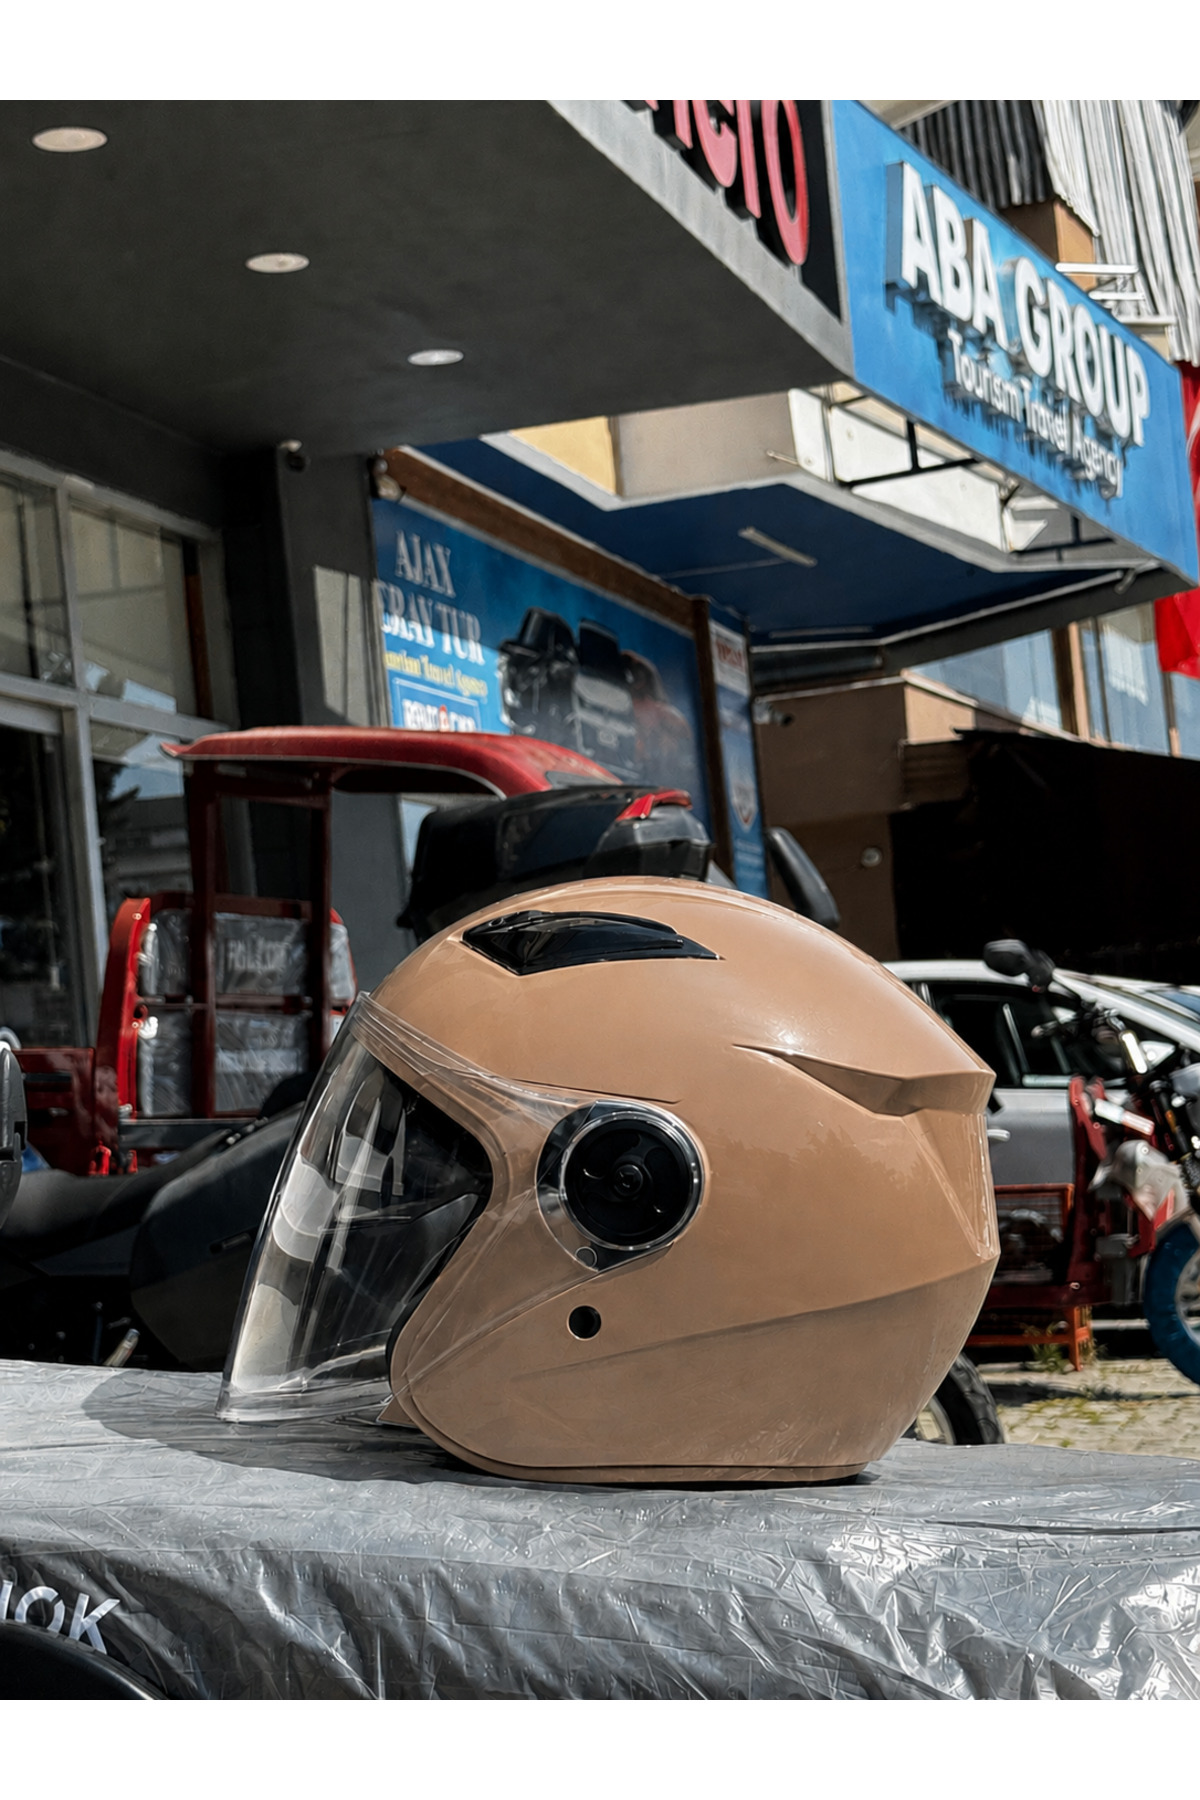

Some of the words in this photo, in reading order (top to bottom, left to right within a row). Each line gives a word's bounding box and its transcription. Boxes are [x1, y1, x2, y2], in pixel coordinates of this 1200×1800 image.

[901, 161, 1010, 352] ABA
[1014, 257, 1150, 447] GROUP
[947, 328, 1022, 423] Tourism
[1019, 378, 1072, 456] Travel
[1071, 411, 1123, 498] Agency
[395, 529, 456, 599] AJAX
[435, 602, 485, 666] TUR
